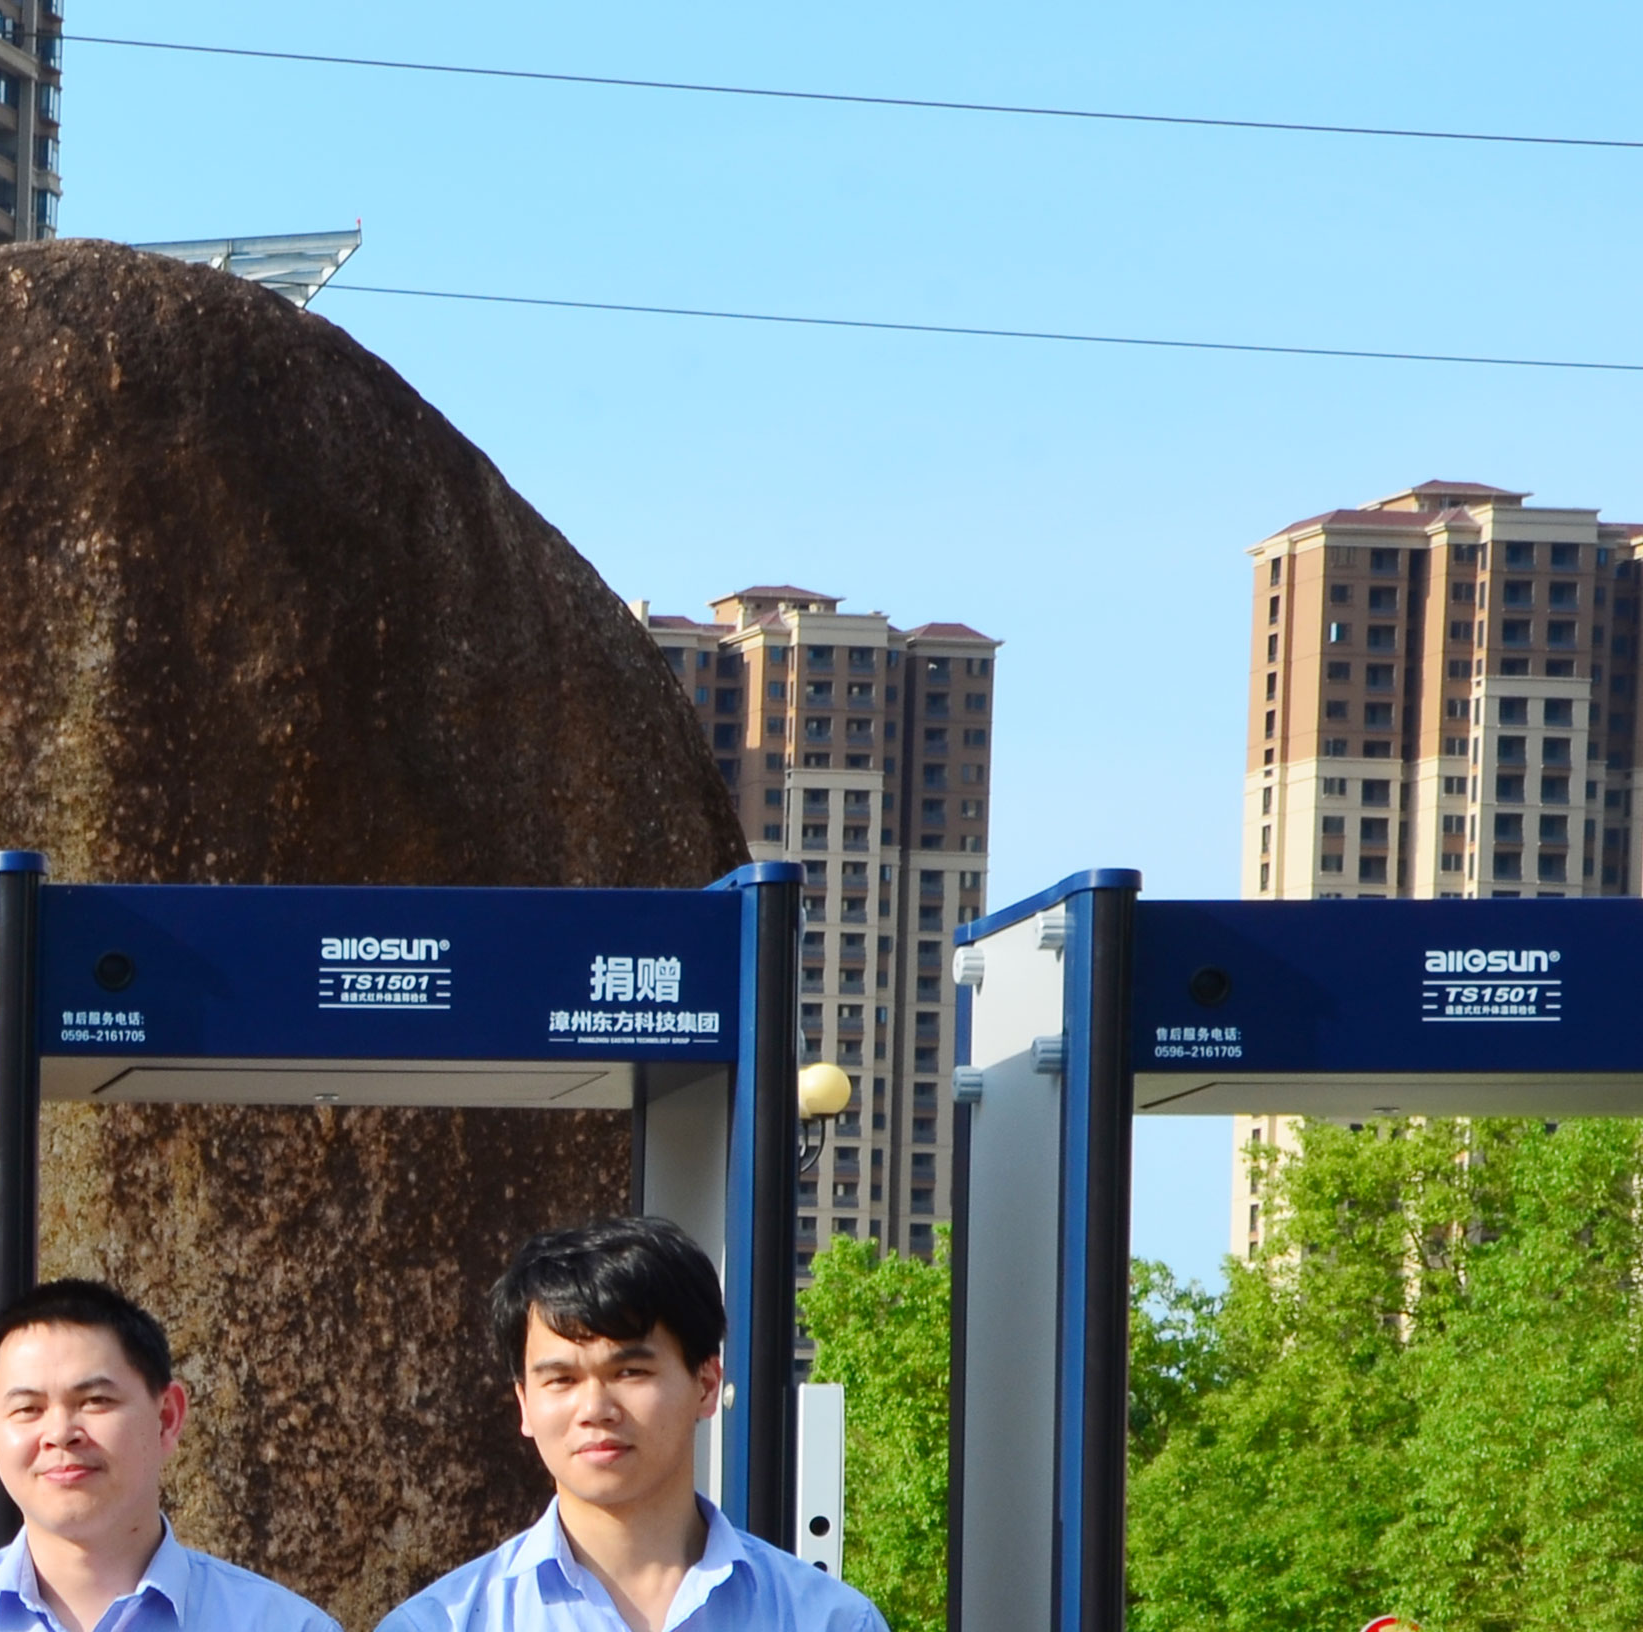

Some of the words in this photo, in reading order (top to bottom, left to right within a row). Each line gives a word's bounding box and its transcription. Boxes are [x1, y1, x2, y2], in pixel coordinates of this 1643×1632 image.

[341, 975, 428, 990] TS1501
[590, 956, 680, 1002] 捐赠
[1446, 987, 1537, 1002] TS1501
[549, 1011, 719, 1032] 漳州东方科技集团
[61, 1030, 145, 1041] 0596-2161705
[1155, 1046, 1242, 1057] 0596-2161705
